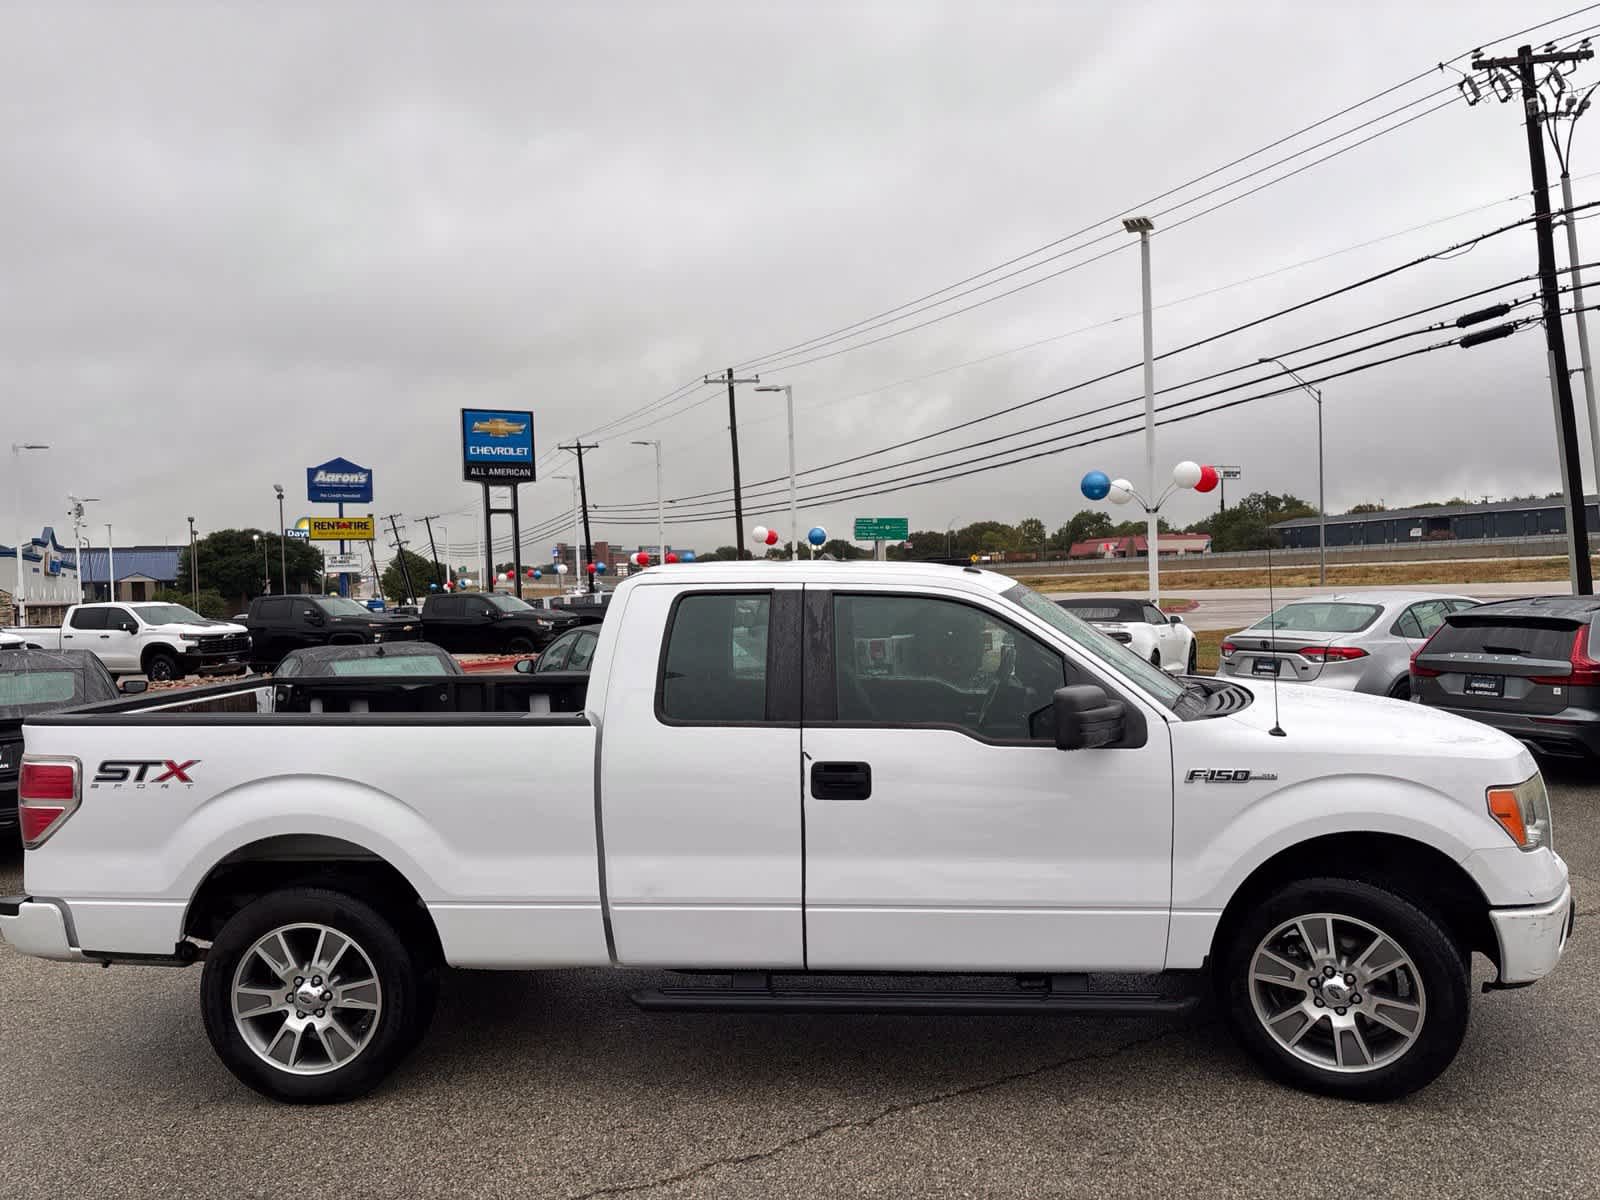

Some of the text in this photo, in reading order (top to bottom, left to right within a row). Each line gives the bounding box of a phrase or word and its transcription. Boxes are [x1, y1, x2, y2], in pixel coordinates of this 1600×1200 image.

[469, 446, 529, 456] CHEVROLET
[313, 470, 369, 484] Aaron's
[470, 467, 531, 477] ALL AMERICAN
[92, 759, 202, 783] STX
[1184, 769, 1251, 784] F-150
